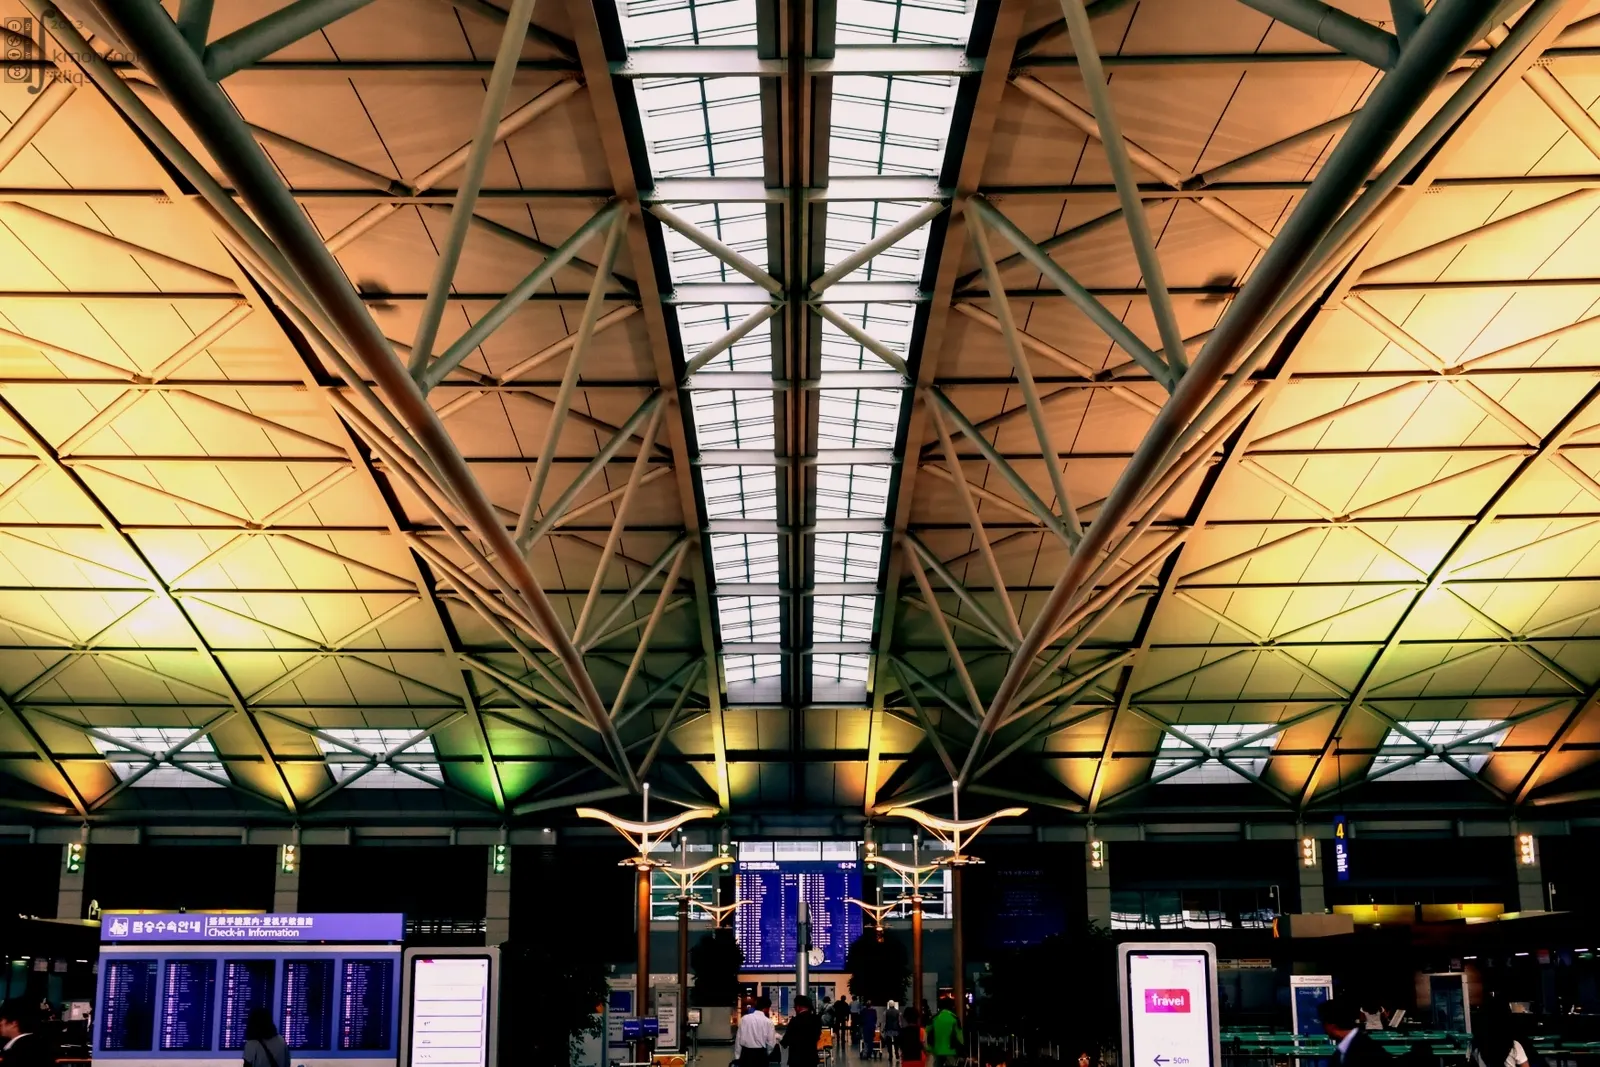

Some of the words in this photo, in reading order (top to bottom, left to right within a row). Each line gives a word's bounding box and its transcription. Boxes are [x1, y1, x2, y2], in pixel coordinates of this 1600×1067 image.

[1336, 823, 1345, 839] 4
[208, 928, 245, 937] Check-in
[248, 928, 300, 937] Information
[1151, 993, 1185, 1007] travel
